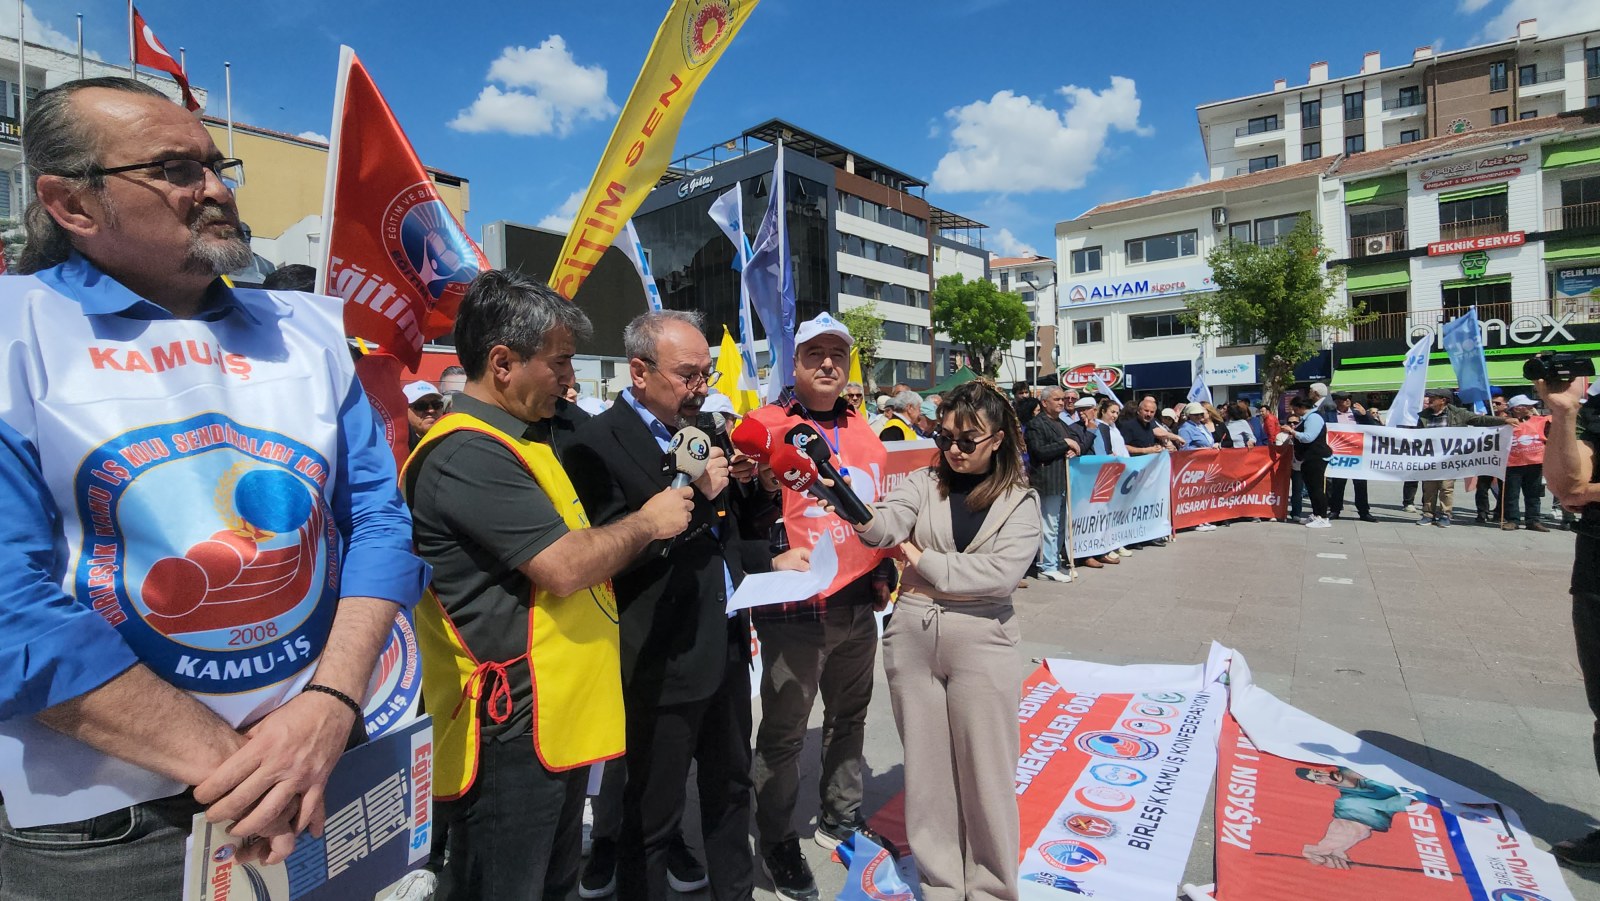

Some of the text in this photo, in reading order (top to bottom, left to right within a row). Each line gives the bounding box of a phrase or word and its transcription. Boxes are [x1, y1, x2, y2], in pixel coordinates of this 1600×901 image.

[625, 73, 683, 167] SEN
[402, 193, 417, 206] VE
[1090, 280, 1186, 300] ALYAM sigorta
[1405, 312, 1577, 349] bimex
[88, 339, 253, 380] KAMU-İŞ
[1212, 367, 1238, 375] Telekom
[119, 437, 171, 468] KOLU
[1371, 428, 1500, 456] IHLARA VADİSİ
[91, 459, 133, 487] İŞ
[1329, 456, 1360, 468] CHP
[1370, 454, 1501, 473] IHLARA BELDE BAŞKANLIĞI
[1181, 470, 1205, 484] CHP
[1175, 499, 1211, 515] AKSARAY
[1217, 492, 1281, 509] BAŞKANLIĞI
[1178, 485, 1208, 499] KADIN
[88, 484, 118, 537] KAMU
[1073, 537, 1107, 553] AKSARA
[229, 622, 279, 646] 2008
[174, 634, 312, 682] KAMU-İŞ
[1015, 713, 1083, 796] EMEKÇİLER
[1161, 755, 1188, 766] İŞ
[1234, 753, 1260, 761] 1
[1151, 764, 1181, 796] KAMU
[1221, 764, 1261, 850] YAŞASIN
[1127, 795, 1169, 850] BİRLEŞİK
[1412, 832, 1454, 882] EMEK
